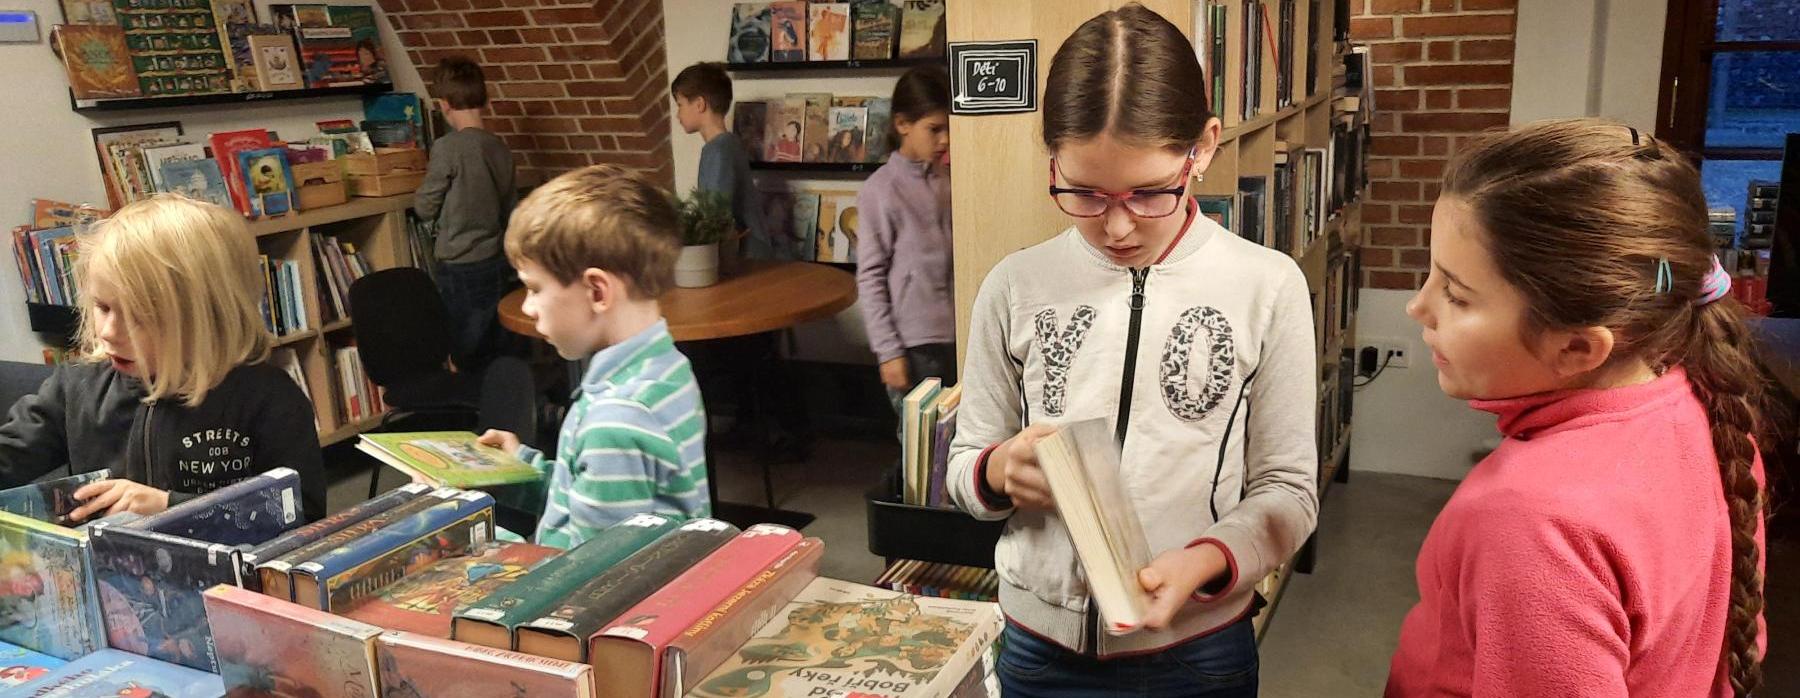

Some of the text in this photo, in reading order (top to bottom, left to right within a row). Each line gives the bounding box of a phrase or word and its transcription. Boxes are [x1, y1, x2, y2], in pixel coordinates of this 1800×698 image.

[977, 77, 1006, 93] 6-10
[182, 428, 250, 448] STREETS
[179, 456, 251, 474] NEW YOR
[788, 667, 910, 693] Bobří řeky
